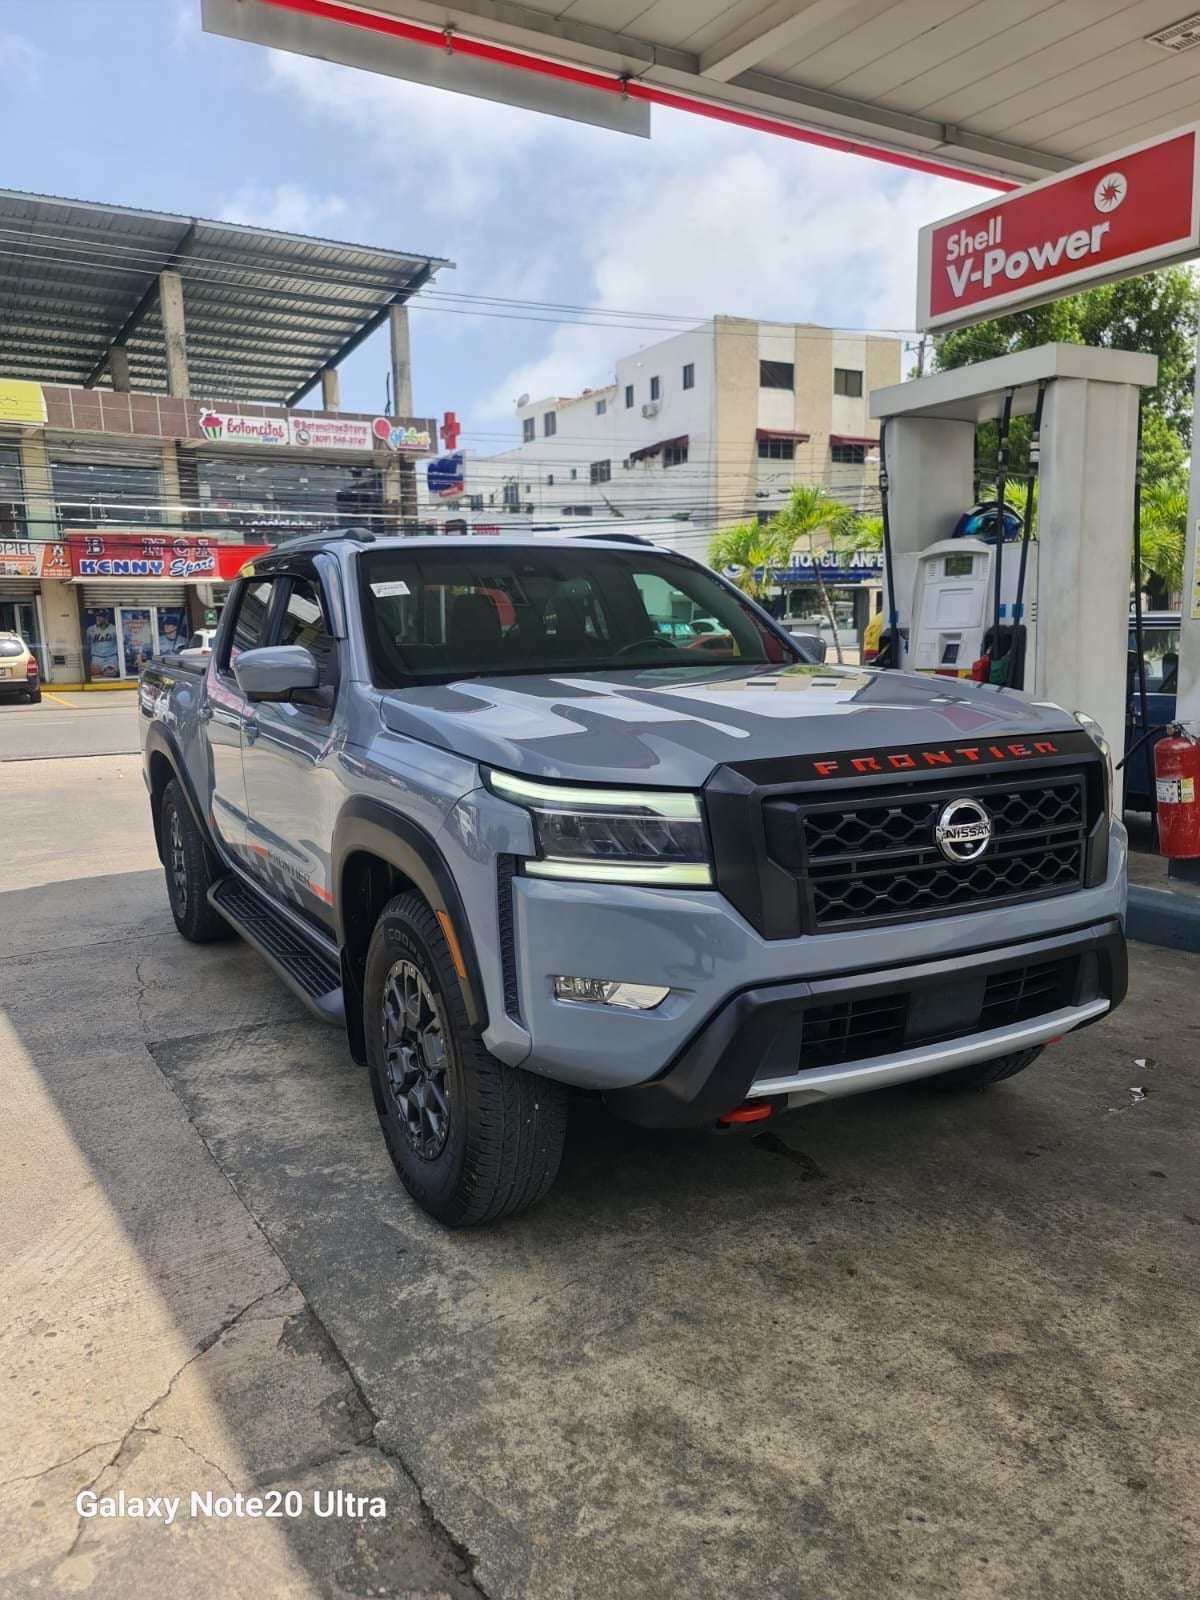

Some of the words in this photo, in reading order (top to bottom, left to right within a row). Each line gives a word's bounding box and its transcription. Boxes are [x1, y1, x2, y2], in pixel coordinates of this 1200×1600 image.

[946, 215, 1003, 262] Shell
[945, 220, 1110, 298] V-Power
[79, 559, 165, 575] KENNY
[169, 557, 215, 577] Sport
[813, 742, 1059, 776] FRONTIER
[943, 823, 992, 841] NISSAN
